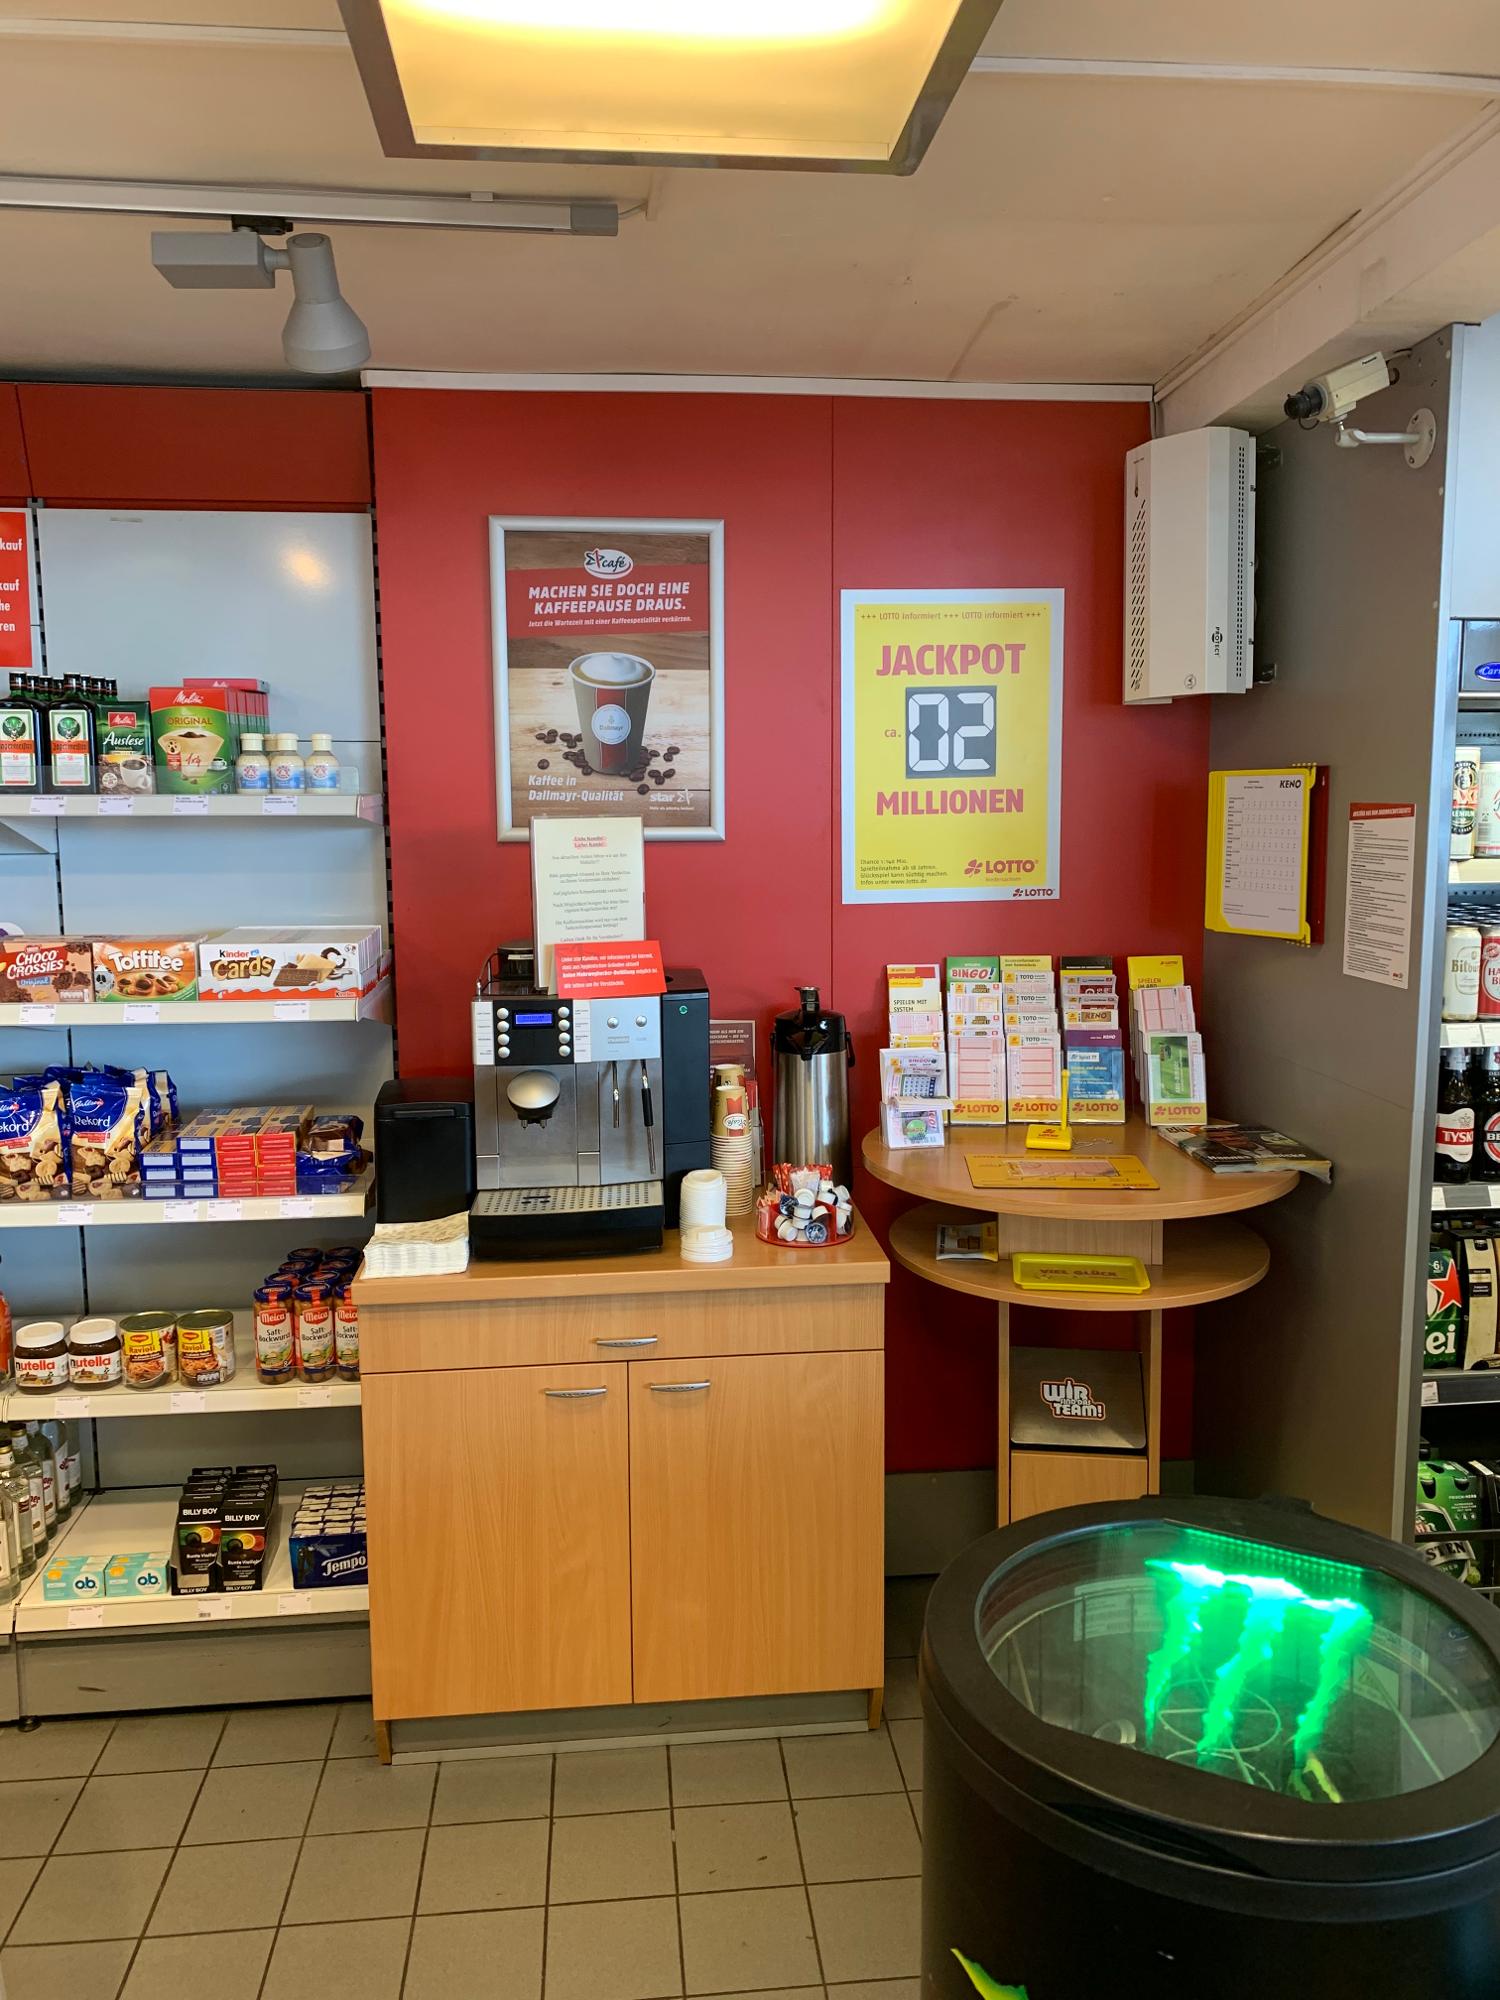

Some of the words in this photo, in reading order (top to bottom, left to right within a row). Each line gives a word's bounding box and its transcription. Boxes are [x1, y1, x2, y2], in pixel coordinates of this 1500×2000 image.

[602, 556, 626, 572] café
[529, 586, 586, 598] MACHEN
[591, 584, 612, 597] SIE
[617, 583, 654, 596] DOCH
[658, 582, 690, 594] EINE
[534, 600, 632, 614] KAFFEEPAUSE
[636, 598, 686, 611] DRAUS.
[876, 644, 1026, 676] JACKPOT
[1482, 666, 1500, 676] Car
[173, 690, 204, 704] Melitta
[168, 717, 212, 725] ORIGINAL
[884, 728, 902, 738] ca.
[908, 692, 994, 772] 02
[103, 731, 144, 746] Auslese
[528, 776, 563, 786] Kaffee
[566, 776, 576, 785] in
[1279, 780, 1301, 789] KENO
[528, 790, 624, 803] Dallmayr-Qualität
[650, 793, 674, 802] star
[876, 788, 1024, 816] MILLIONEN
[986, 861, 1035, 873] LOTTO
[16, 950, 57, 965] CHOCO
[109, 950, 184, 972] Toffifee
[7, 959, 64, 979] CROSSIES
[952, 967, 994, 979] BINGO!
[20, 978, 50, 986] Original
[967, 1104, 999, 1113] LOTTO
[1026, 1103, 1058, 1111] LOTTO
[1086, 1103, 1119, 1111] LOTTO
[1168, 1107, 1200, 1115] LOTTO
[74, 1116, 110, 1127] Rekord
[262, 1312, 285, 1322] Meica
[305, 1312, 328, 1322] Meica
[267, 1328, 282, 1336] Saft-
[311, 1327, 326, 1335] Saft-
[259, 1332, 290, 1342] Bockwurst
[16, 1360, 56, 1371] nutella
[71, 1356, 110, 1368] nutella
[1044, 1381, 1088, 1402] WIR
[1054, 1403, 1102, 1418] TEAM!
[183, 1508, 201, 1516] BILLY
[325, 1556, 366, 1576] Tempo
